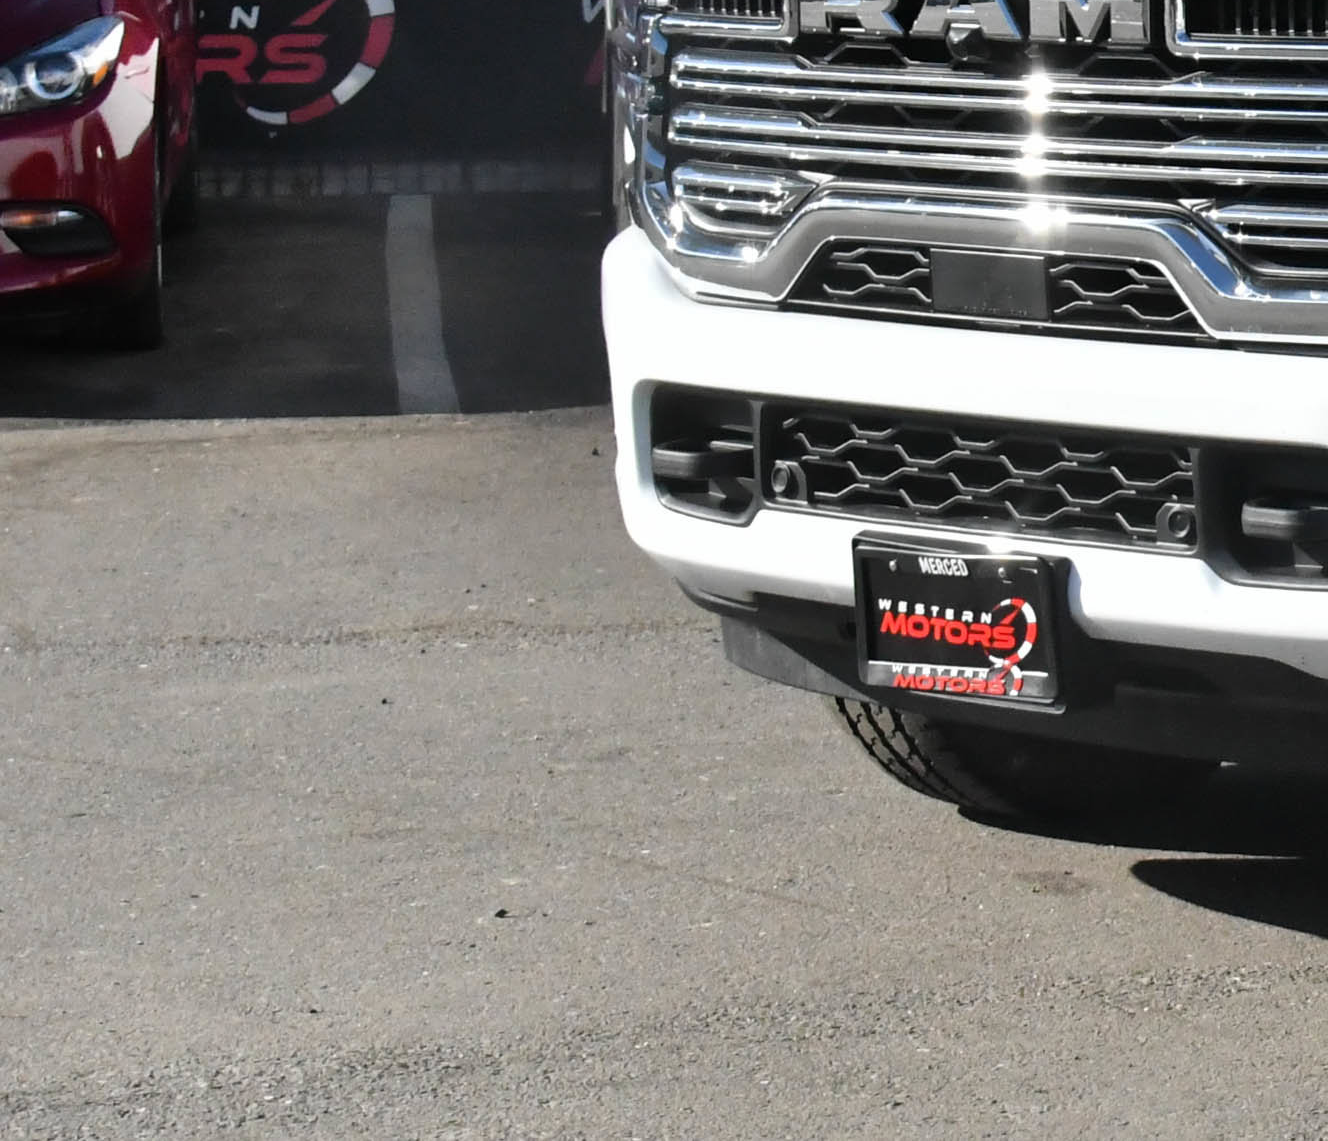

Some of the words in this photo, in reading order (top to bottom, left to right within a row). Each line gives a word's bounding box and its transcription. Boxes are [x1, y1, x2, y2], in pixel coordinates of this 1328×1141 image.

[918, 557, 969, 577] MERCED
[878, 598, 993, 625] WESTERN
[880, 610, 1016, 649] MOTORS
[891, 663, 990, 679] WESTERN
[893, 673, 1007, 695] MOTORS
